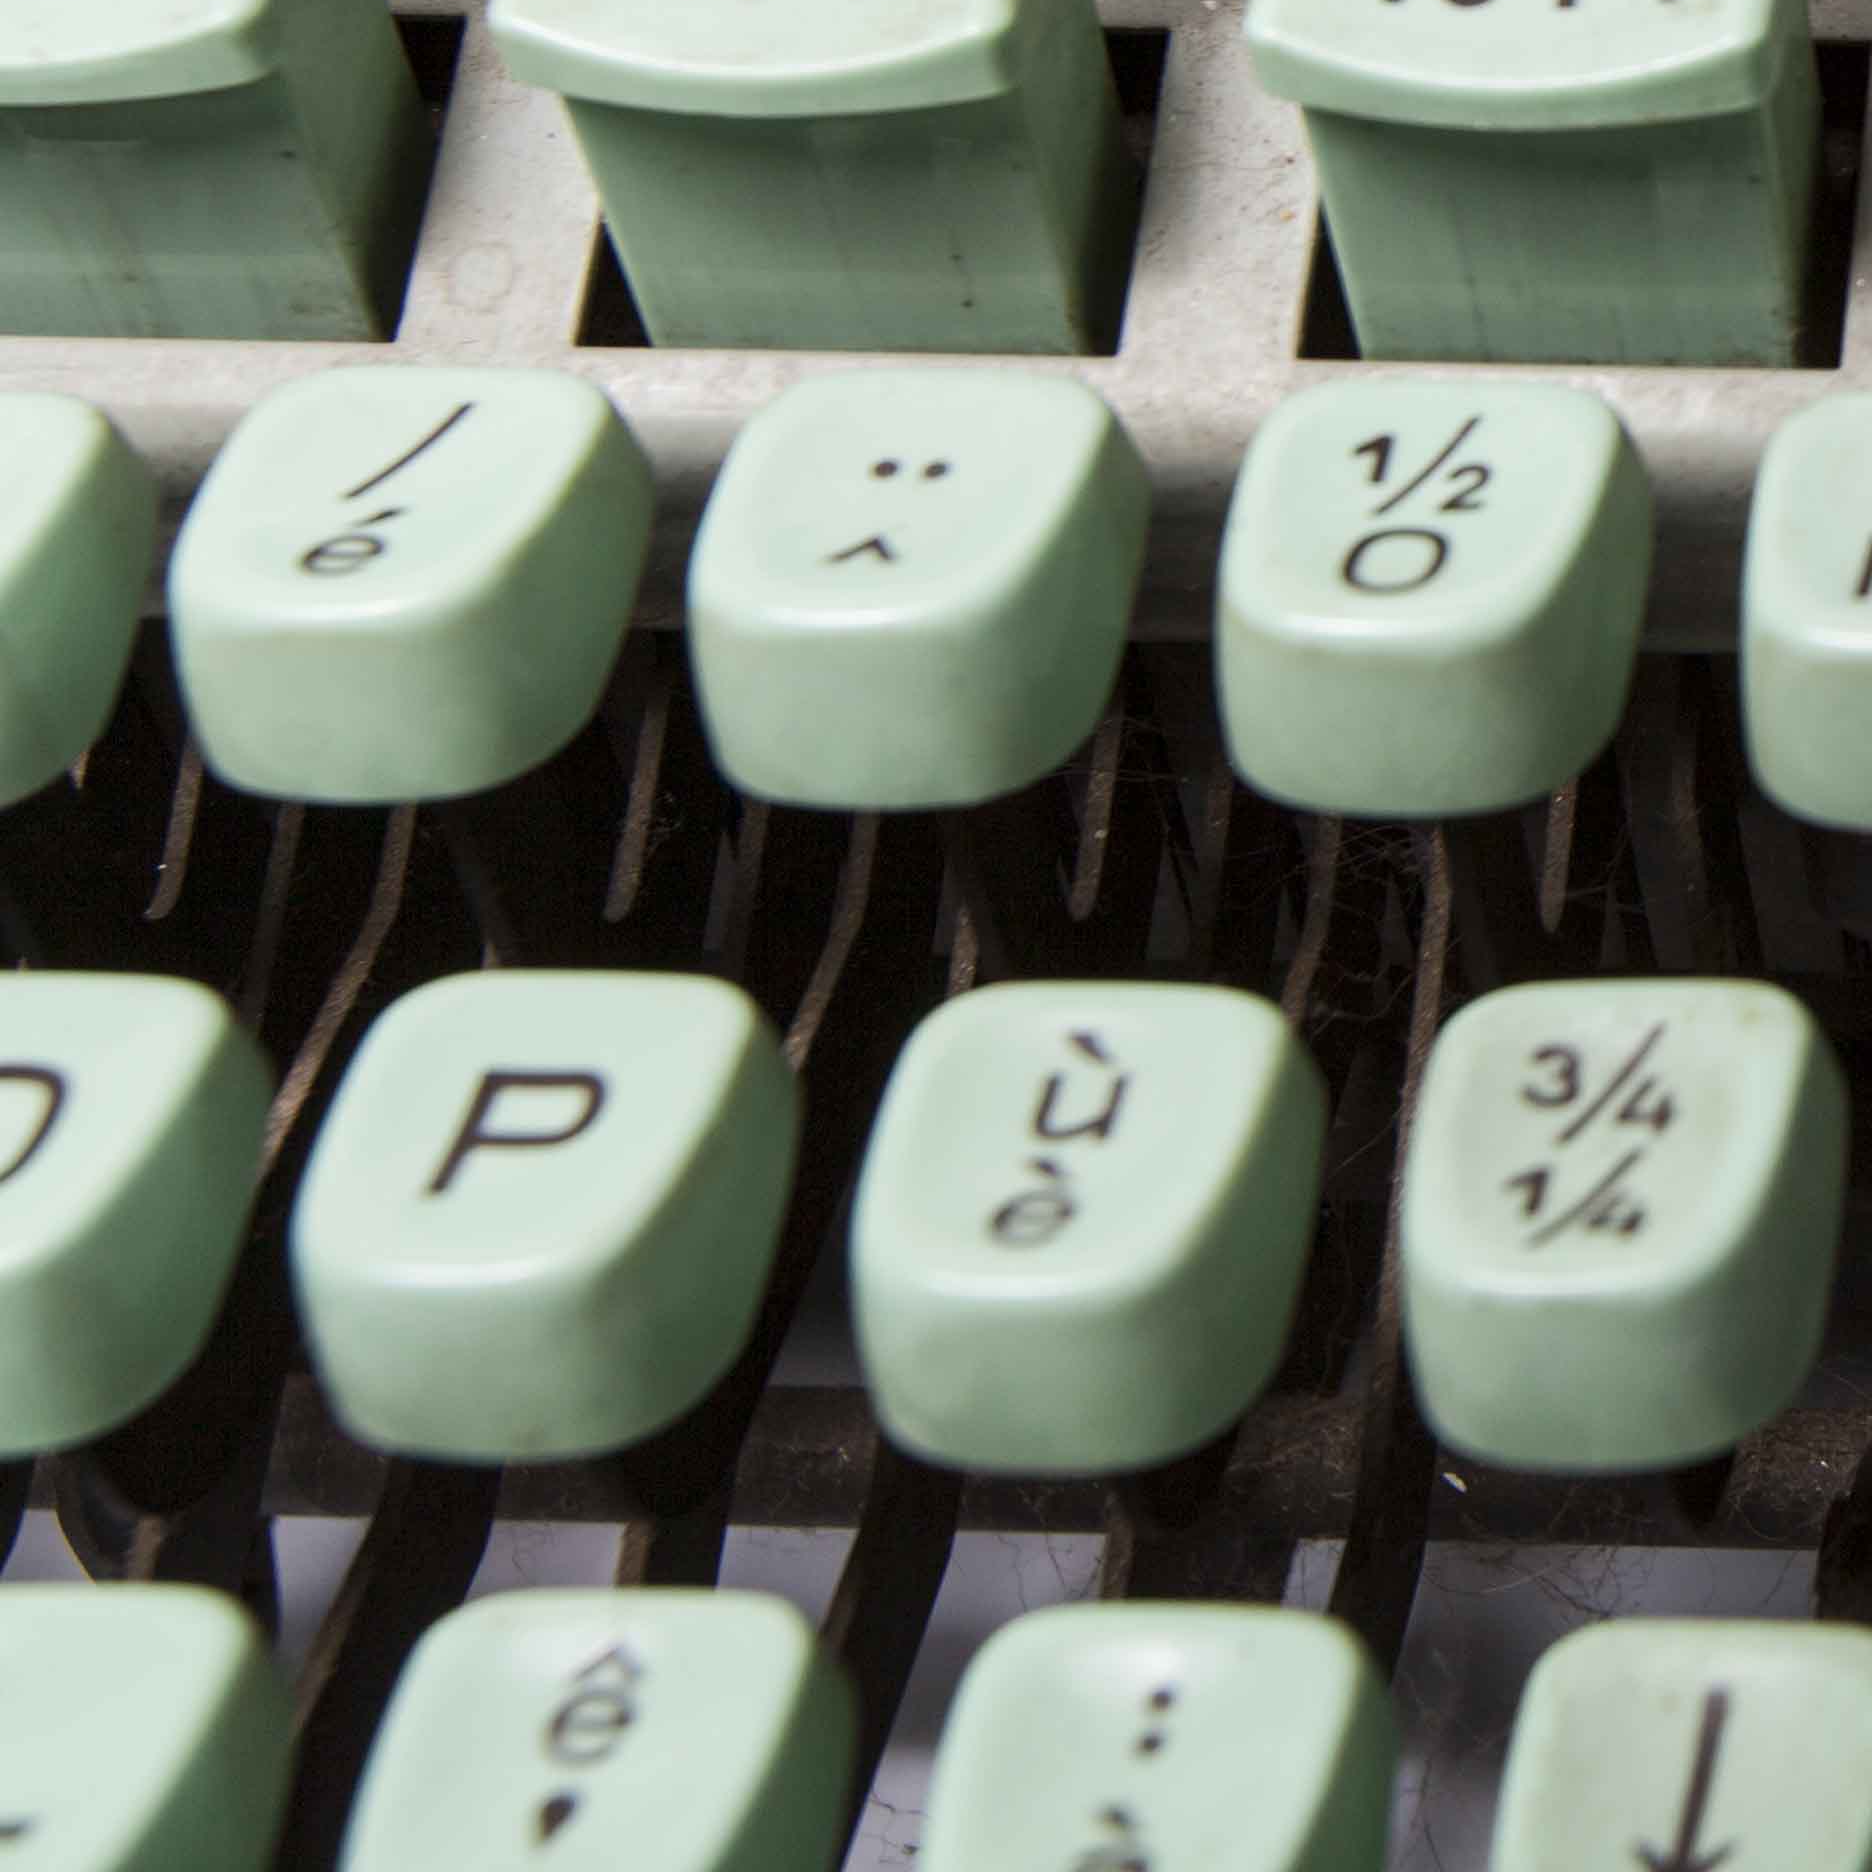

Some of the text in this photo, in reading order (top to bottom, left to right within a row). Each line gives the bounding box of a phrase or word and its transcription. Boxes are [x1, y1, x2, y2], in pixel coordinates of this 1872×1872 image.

[427, 1068, 608, 1196] P
[1519, 1024, 1677, 1145] 3/4
[1506, 1149, 1648, 1245] 1/4
